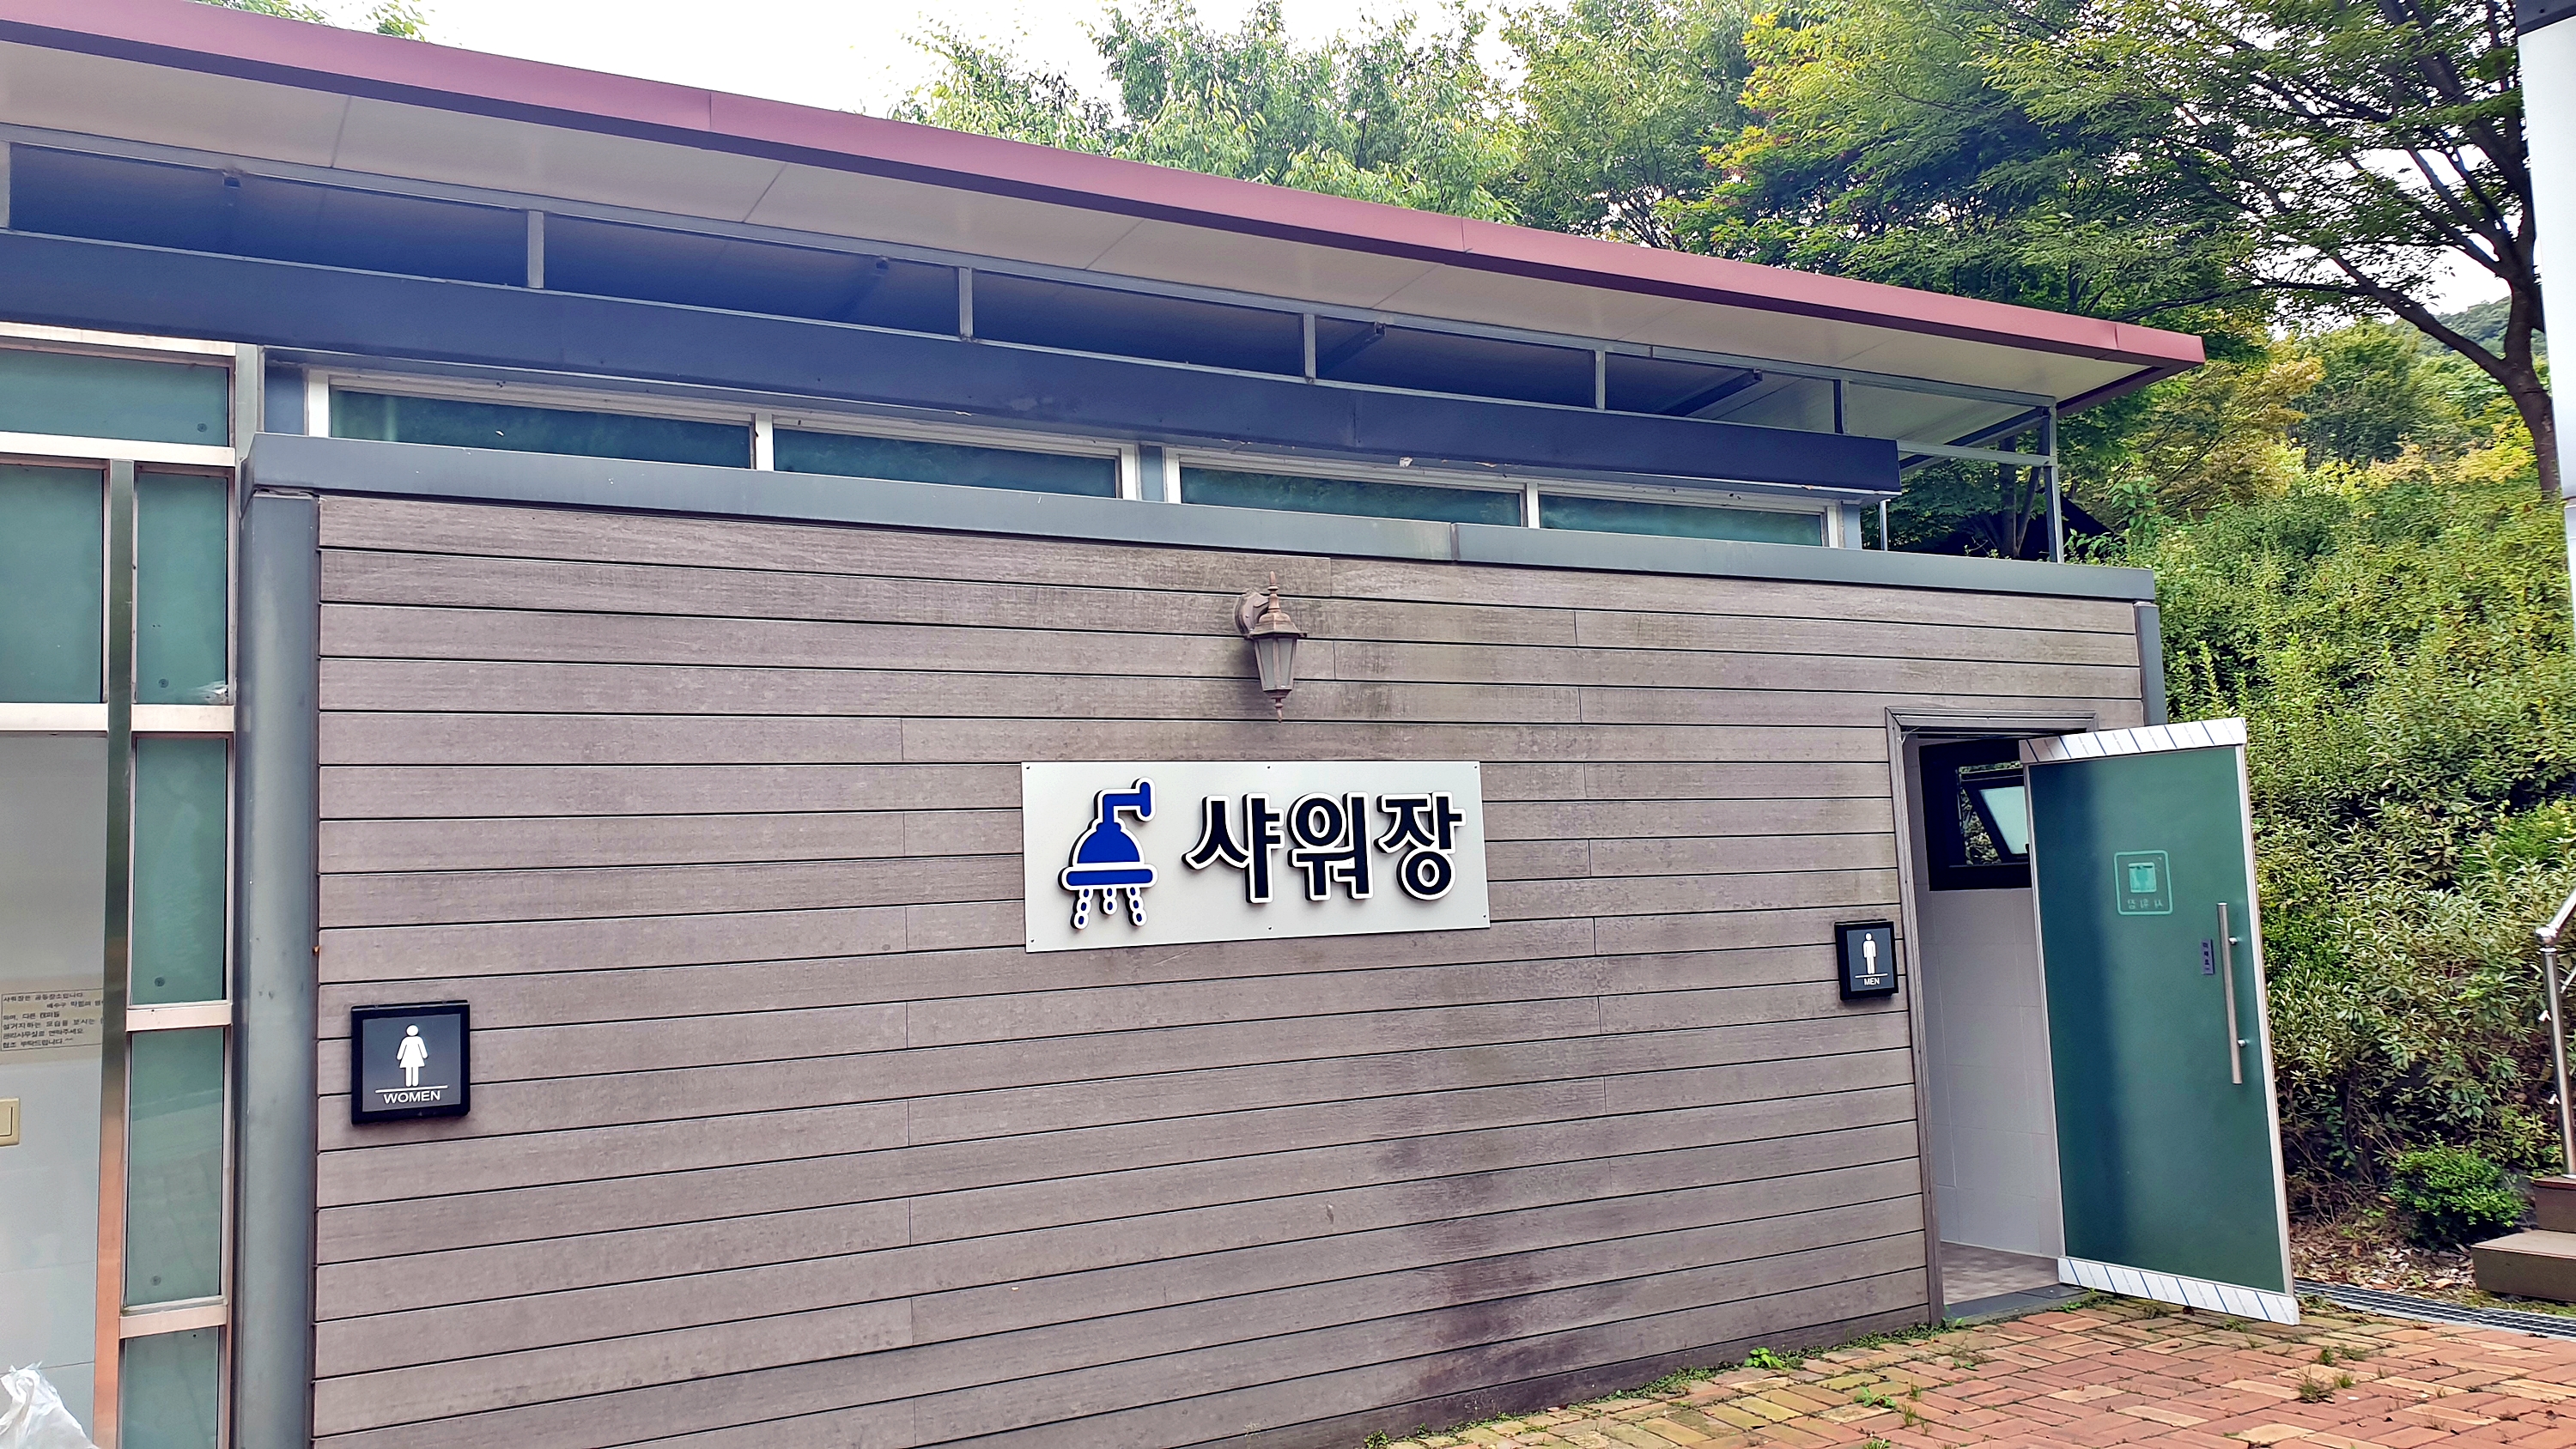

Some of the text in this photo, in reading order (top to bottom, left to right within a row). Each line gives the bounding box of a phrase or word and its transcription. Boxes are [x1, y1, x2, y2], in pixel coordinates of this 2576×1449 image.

[1182, 791, 1466, 903] 샤워장
[1863, 977, 1880, 986] MEN
[383, 1090, 440, 1104] WOMEN
